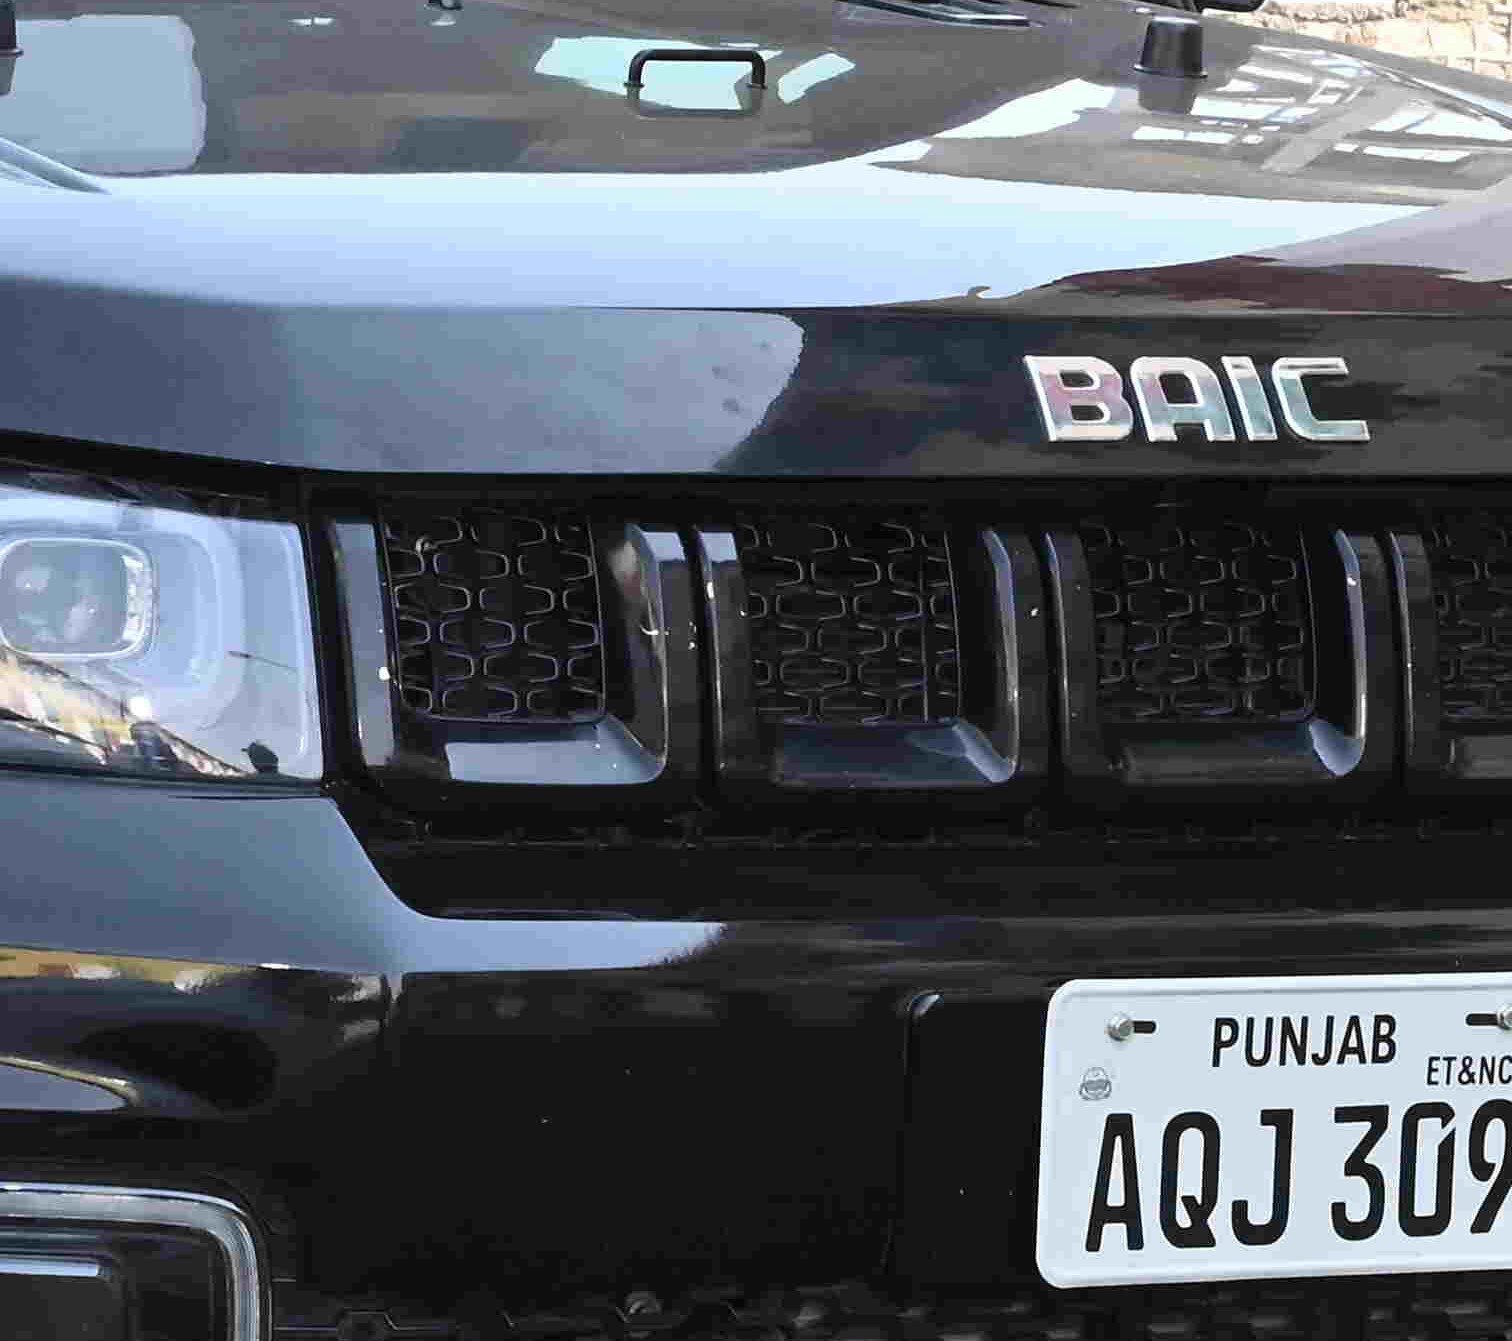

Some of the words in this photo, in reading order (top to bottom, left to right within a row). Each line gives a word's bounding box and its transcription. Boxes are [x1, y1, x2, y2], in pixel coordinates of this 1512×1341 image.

[1023, 355, 1370, 442] BAIC
[1211, 1013, 1398, 1068] PUNJAB
[1085, 1107, 1295, 1253] AQJ
